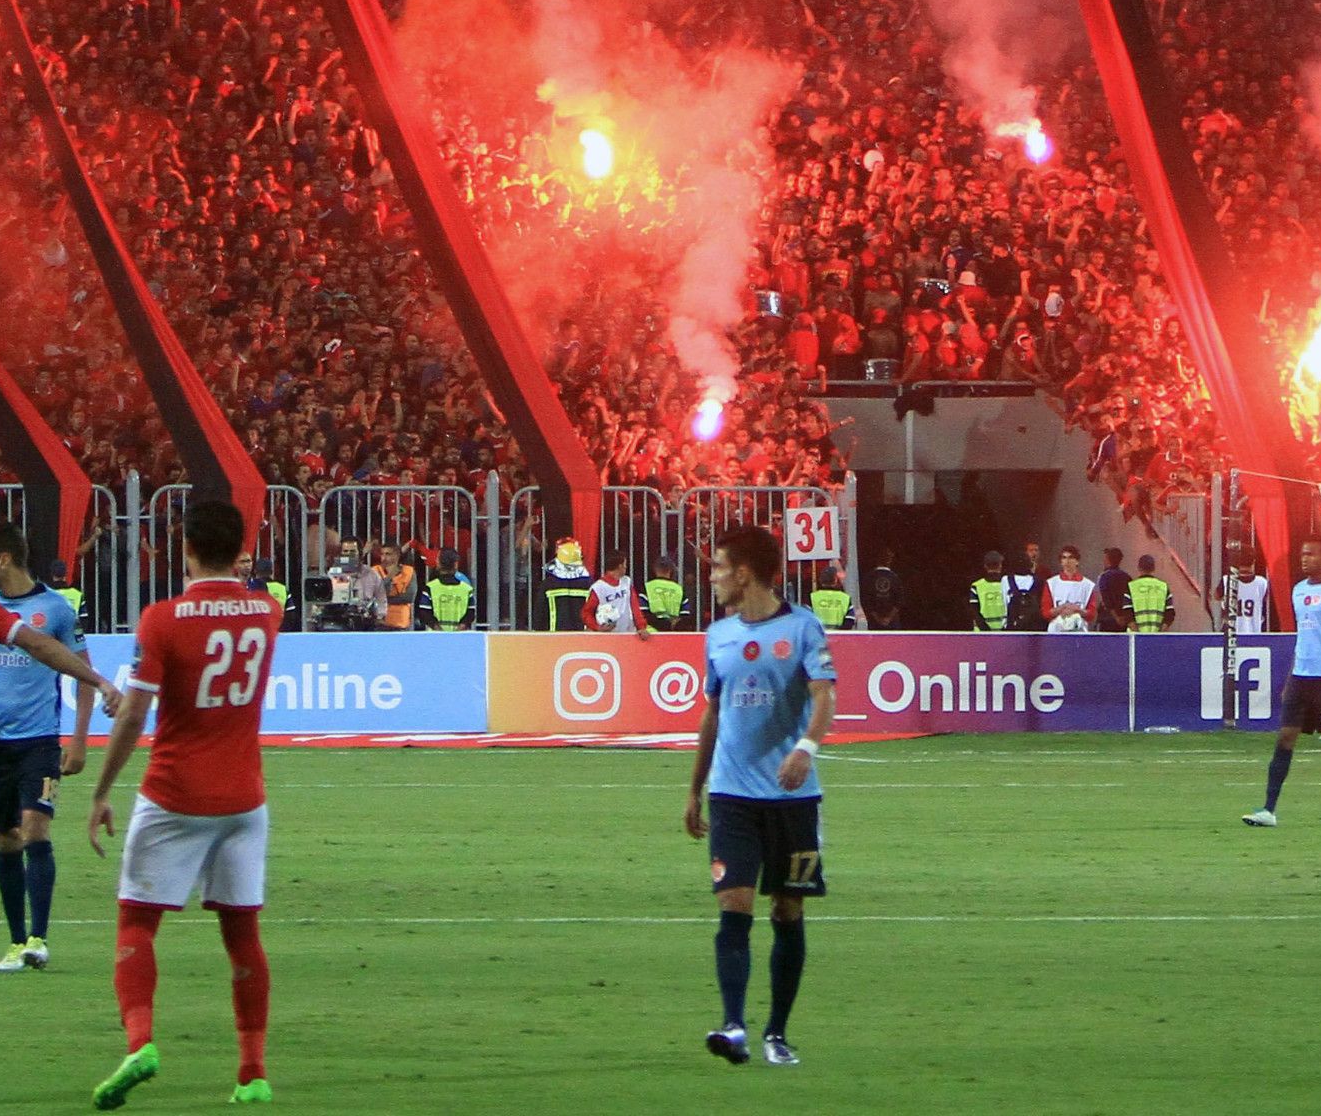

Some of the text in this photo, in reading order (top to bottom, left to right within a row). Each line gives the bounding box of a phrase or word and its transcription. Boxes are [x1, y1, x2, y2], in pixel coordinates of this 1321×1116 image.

[794, 511, 833, 554] 31
[605, 589, 628, 603] CAF
[1237, 599, 1255, 617] 19
[196, 627, 267, 709] 23
[789, 851, 819, 883] 17
